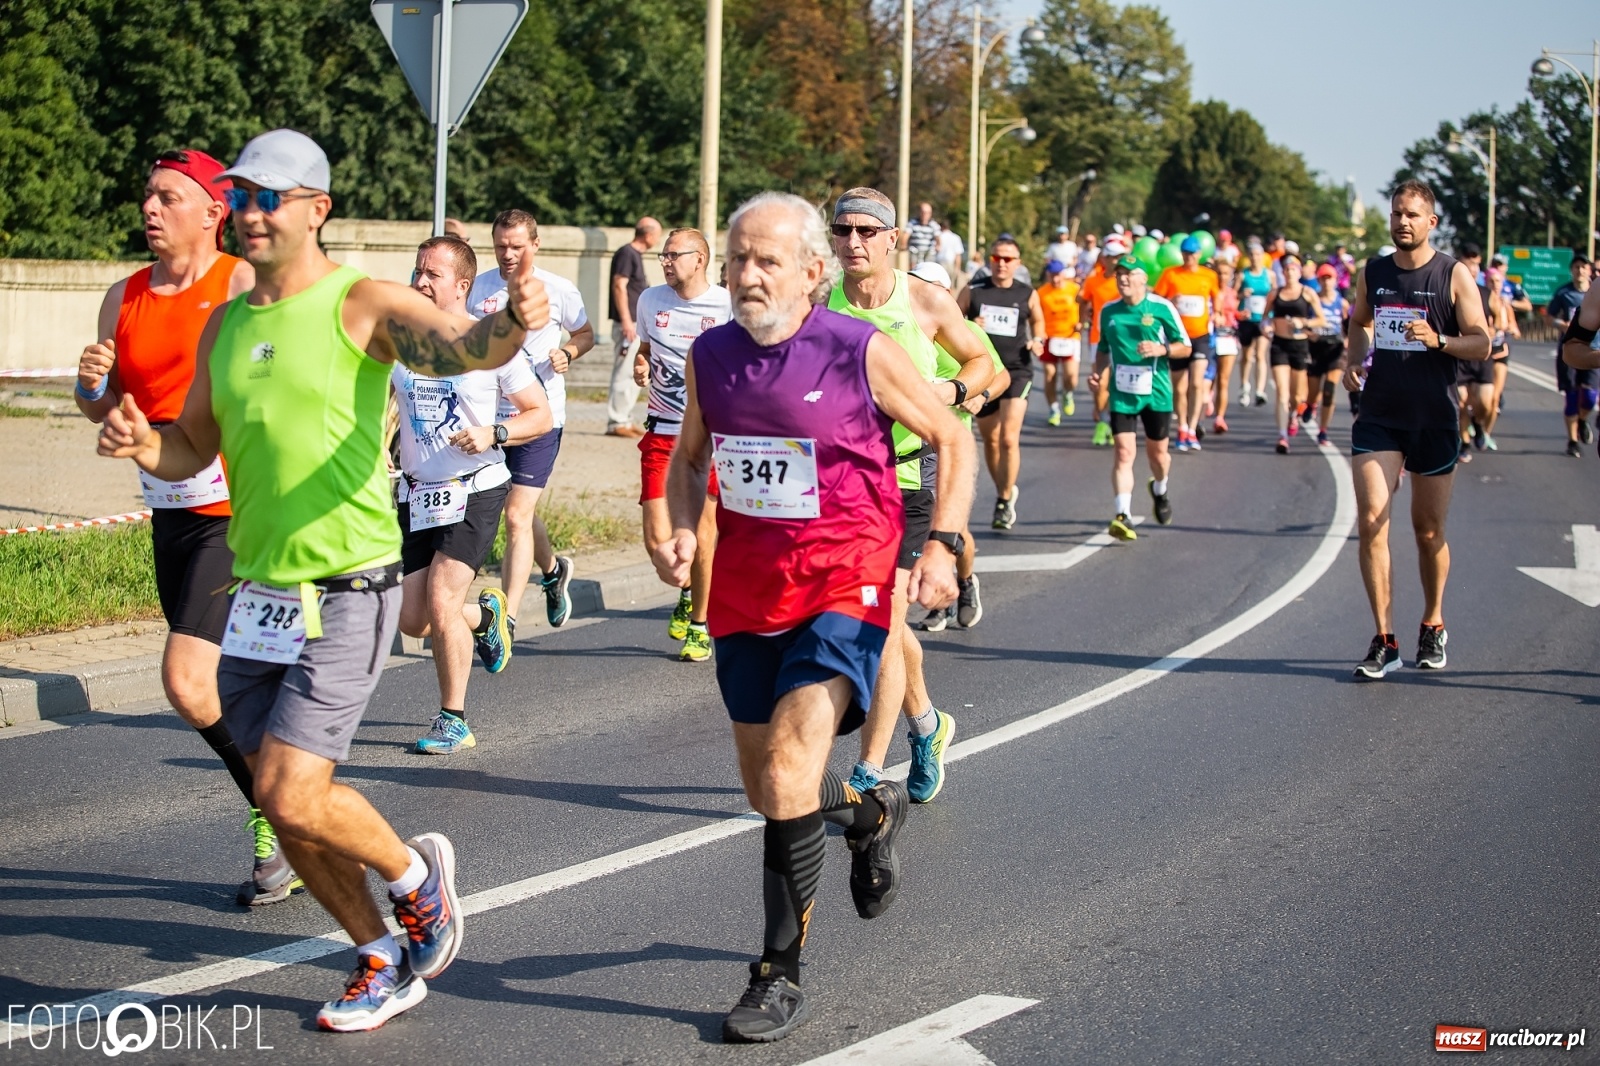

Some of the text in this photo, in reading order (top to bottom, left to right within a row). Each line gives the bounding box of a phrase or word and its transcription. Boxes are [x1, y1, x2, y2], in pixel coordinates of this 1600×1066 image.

[993, 315, 1008, 323] 144
[890, 321, 904, 329] 4F
[416, 386, 449, 395] PÓŁMARATON
[417, 394, 438, 402] ZIMOWY
[803, 390, 824, 403] 4F
[741, 459, 789, 485] 347
[423, 490, 452, 509] 383
[258, 602, 300, 630] 248
